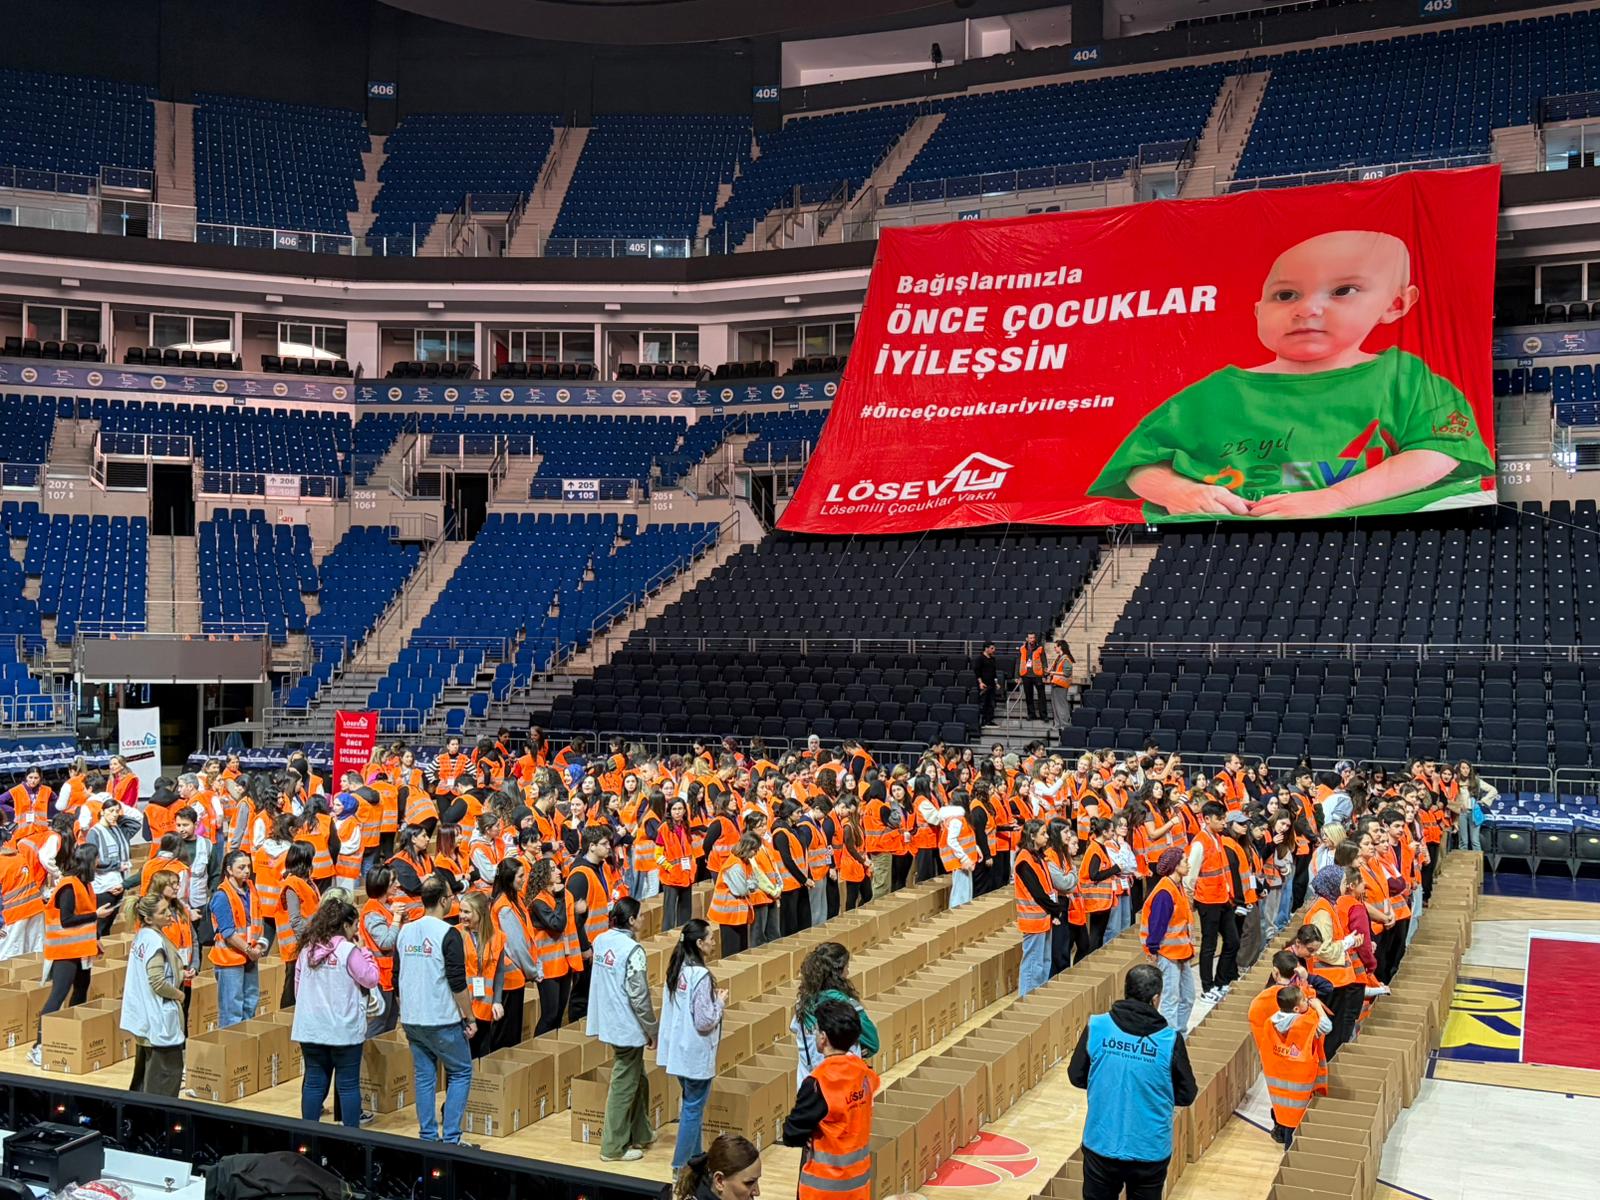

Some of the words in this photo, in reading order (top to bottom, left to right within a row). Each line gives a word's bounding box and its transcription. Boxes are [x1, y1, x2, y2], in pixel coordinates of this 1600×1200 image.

[1424, 0, 1452, 11] 403
[1074, 49, 1097, 61] 404
[371, 84, 394, 96] 406
[756, 88, 778, 99] 405
[279, 237, 297, 247] 406
[629, 243, 646, 253] 405
[896, 266, 1083, 296] Bağışlarınızla
[887, 303, 988, 335] ÖNCE
[1002, 285, 1218, 339] ÇOCUKLAR
[874, 339, 1068, 380] İYİLEŞSİN
[860, 394, 1115, 422] #ÖnceÇocuklarİyileşsin
[1503, 463, 1524, 471] 203
[1503, 475, 1524, 484] 103
[49, 481, 67, 489] 207
[578, 481, 595, 489] 205
[826, 478, 953, 502] LÖSEV
[48, 491, 66, 500] 107
[354, 491, 371, 499] 206
[578, 491, 594, 499] 105
[653, 493, 668, 501] 205
[354, 501, 371, 509] 106
[653, 503, 668, 511] 105
[820, 502, 885, 516] Lösemili
[887, 496, 954, 516] Çocuklar
[957, 491, 997, 502] Vakfı
[1102, 1036, 1140, 1053] LÖSEV
